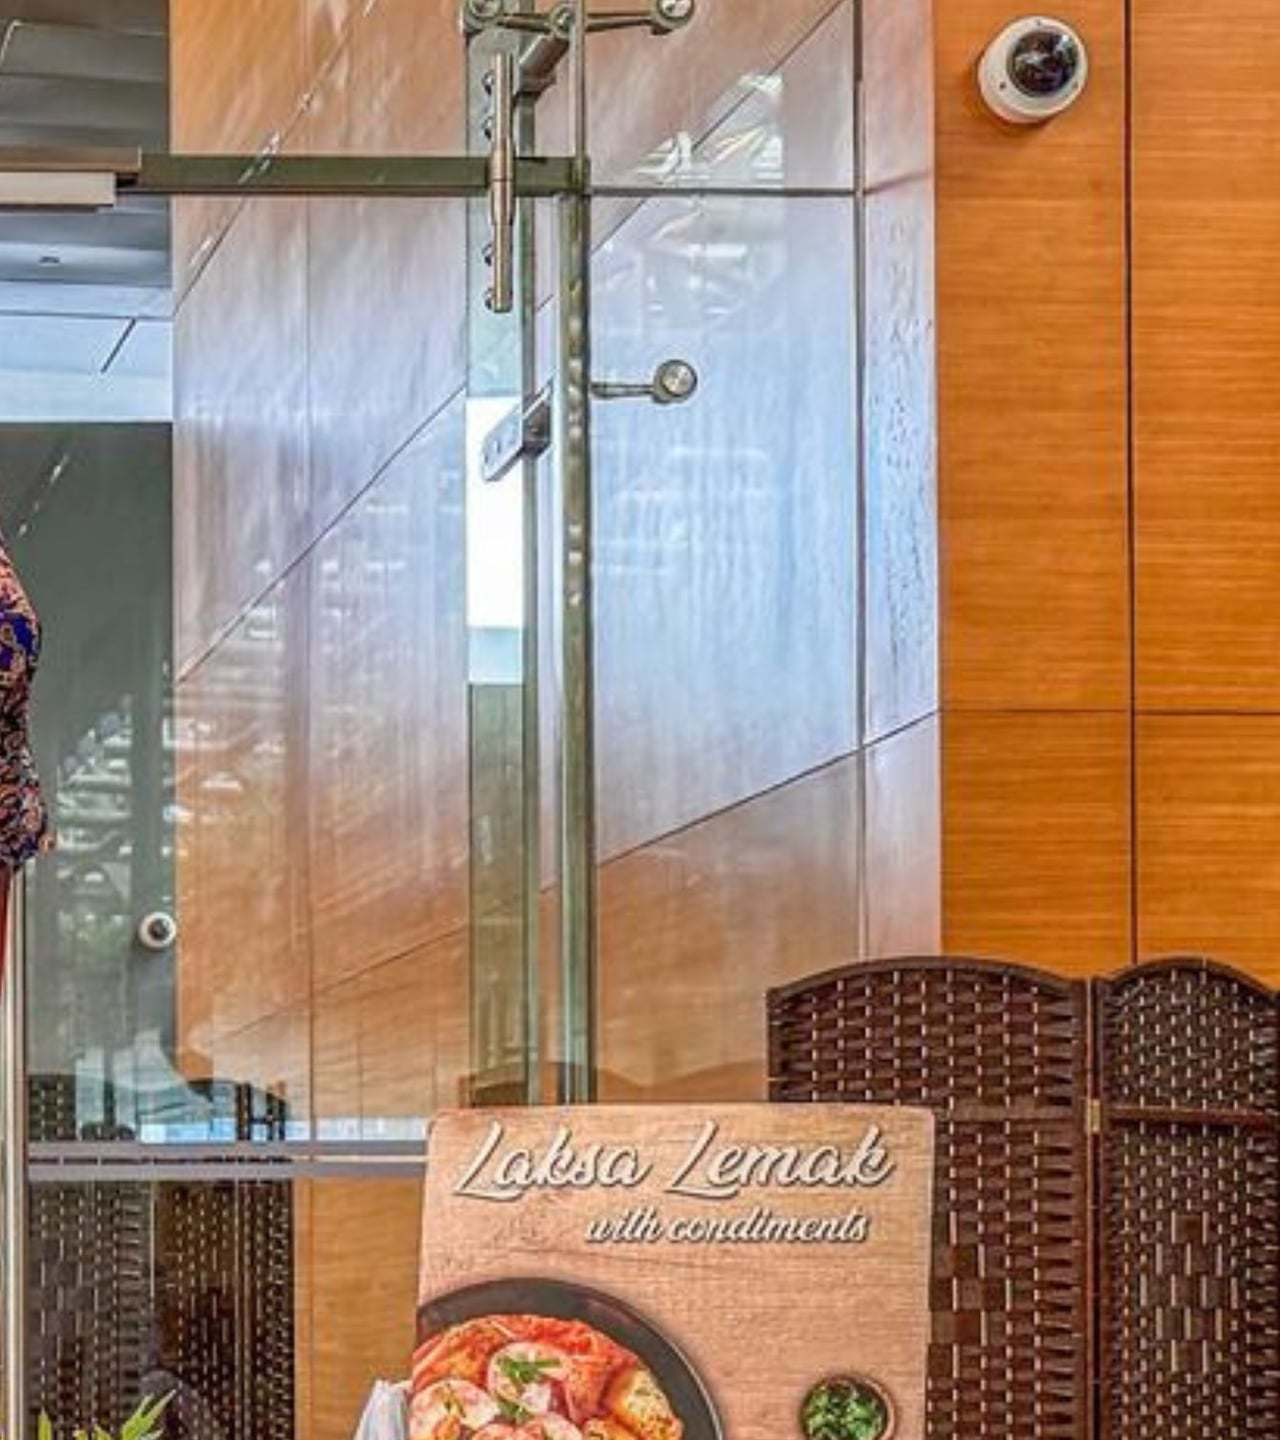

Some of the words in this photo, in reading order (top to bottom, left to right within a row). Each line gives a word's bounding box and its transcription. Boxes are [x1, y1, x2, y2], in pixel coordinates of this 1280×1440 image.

[453, 1119, 653, 1202] Laksa
[663, 1118, 896, 1199] Lemak
[584, 1204, 663, 1243] with
[667, 1204, 870, 1244] condiments
